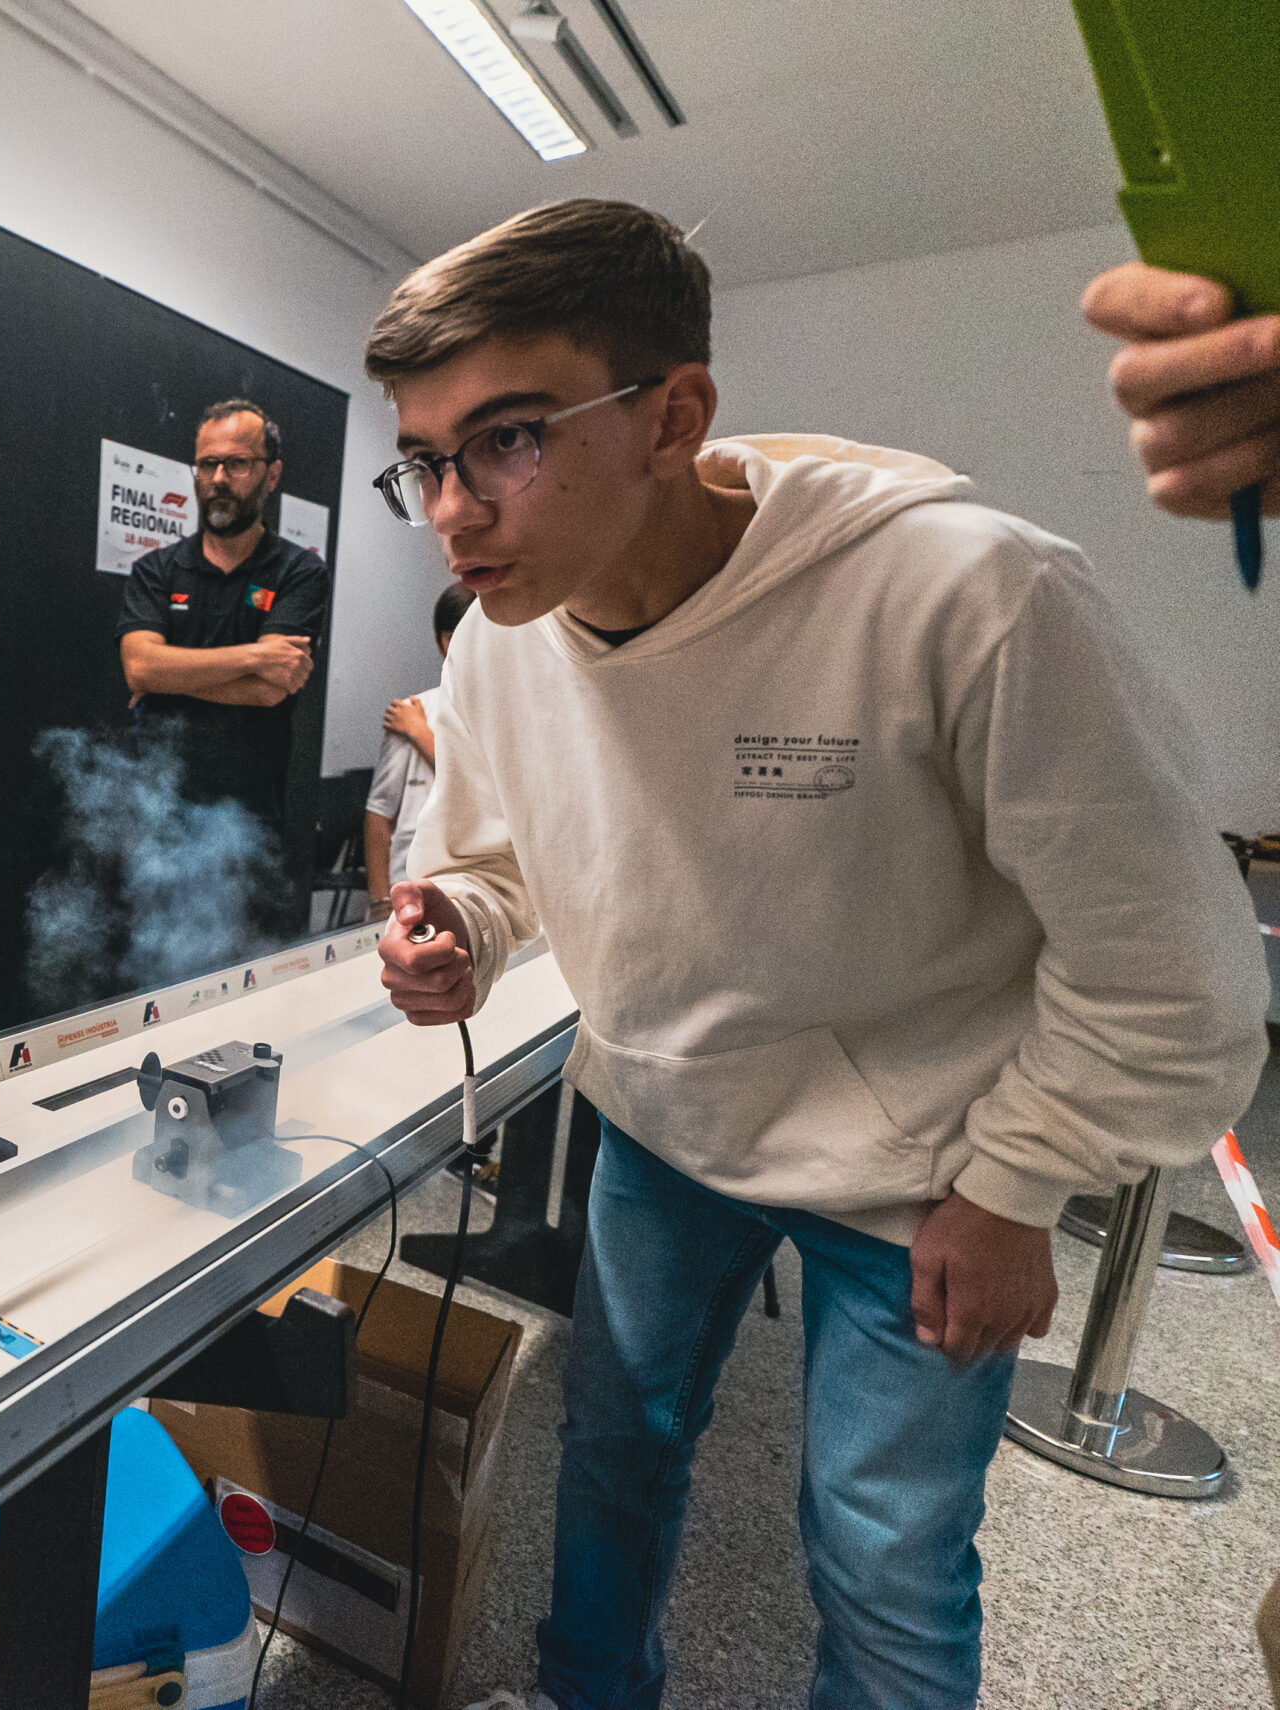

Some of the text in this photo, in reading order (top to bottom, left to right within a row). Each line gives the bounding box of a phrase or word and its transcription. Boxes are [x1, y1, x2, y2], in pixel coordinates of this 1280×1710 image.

[111, 484, 156, 512] FINAL
[734, 734, 860, 746] design your future
